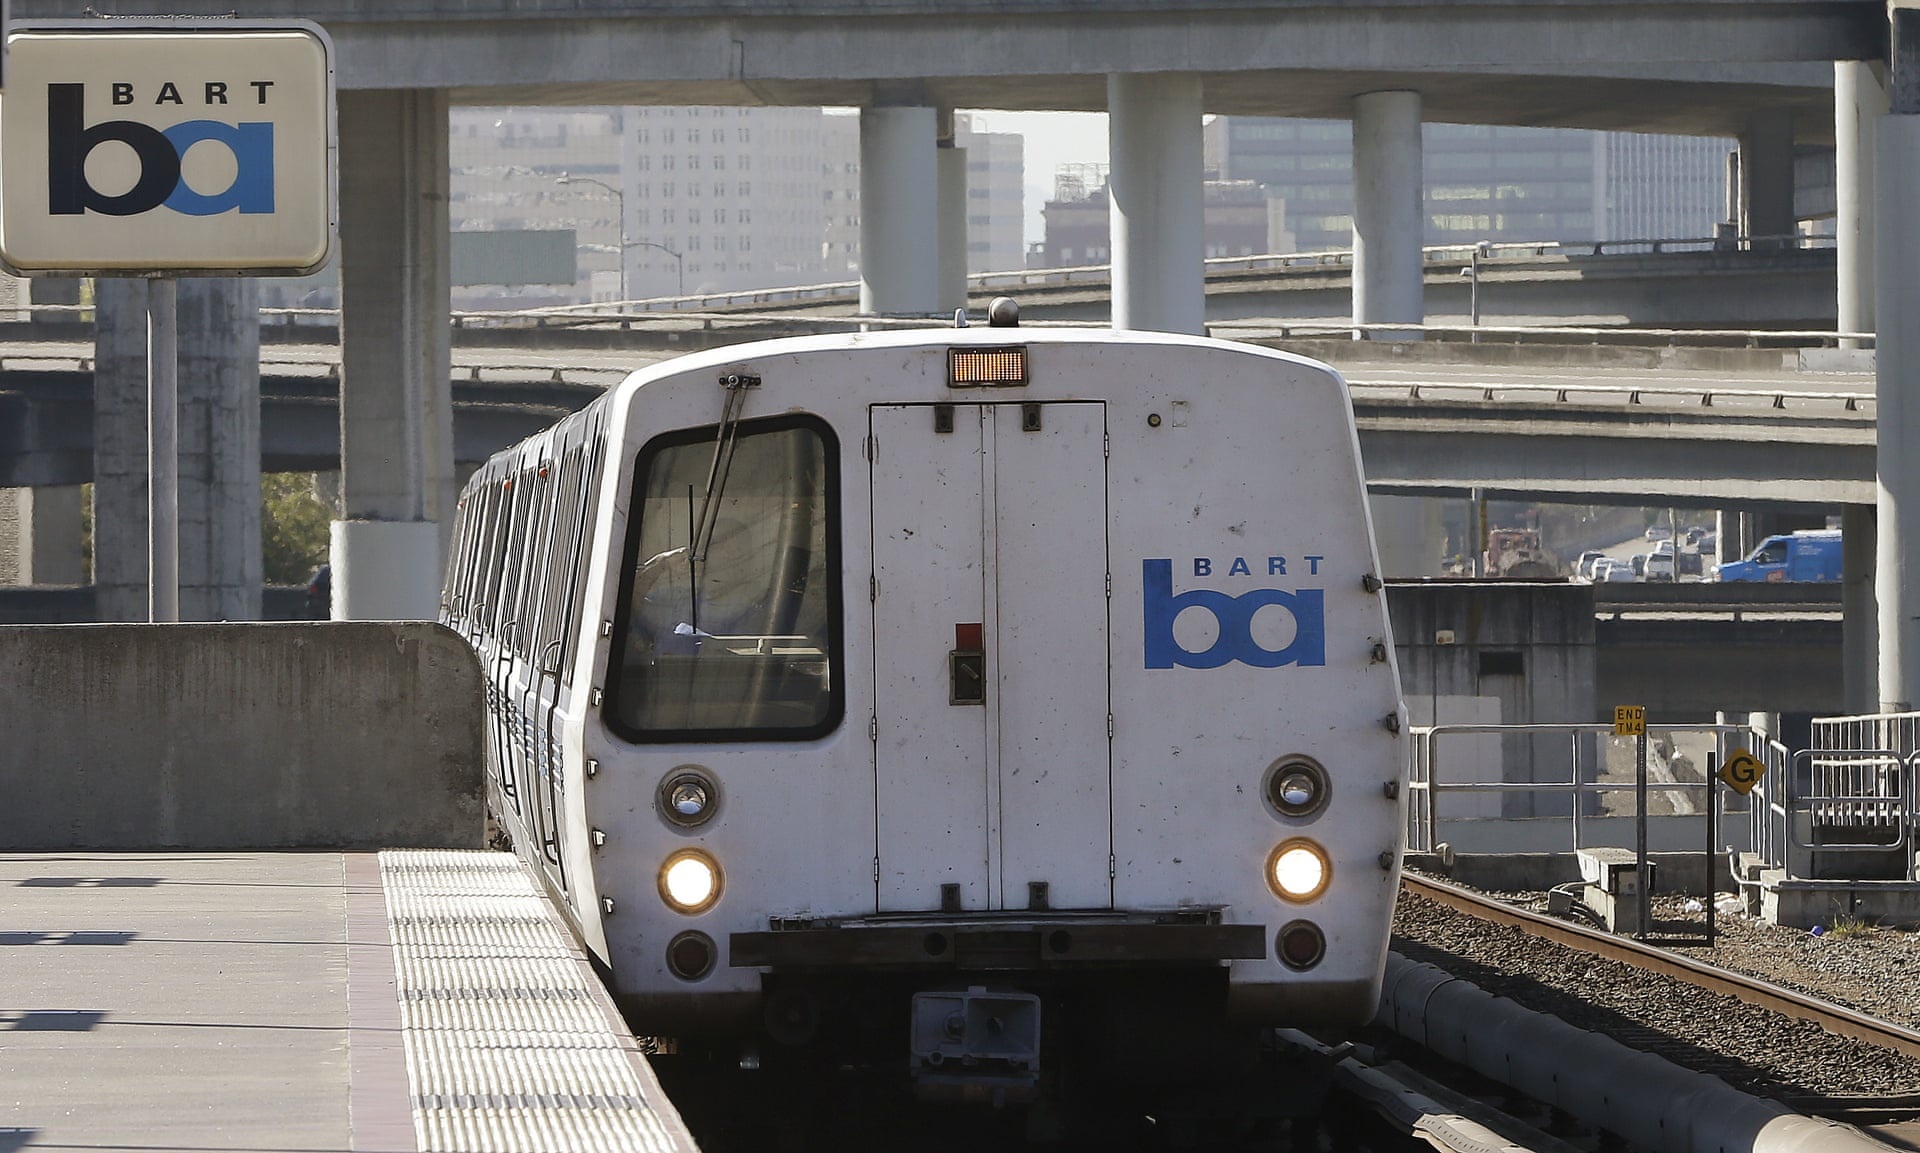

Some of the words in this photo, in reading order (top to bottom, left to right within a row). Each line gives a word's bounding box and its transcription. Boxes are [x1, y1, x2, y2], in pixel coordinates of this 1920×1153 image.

[112, 81, 274, 105] BART
[1194, 556, 1324, 577] BART
[1617, 709, 1642, 720] END
[1618, 722, 1643, 733] TM4
[1731, 757, 1755, 783] G
